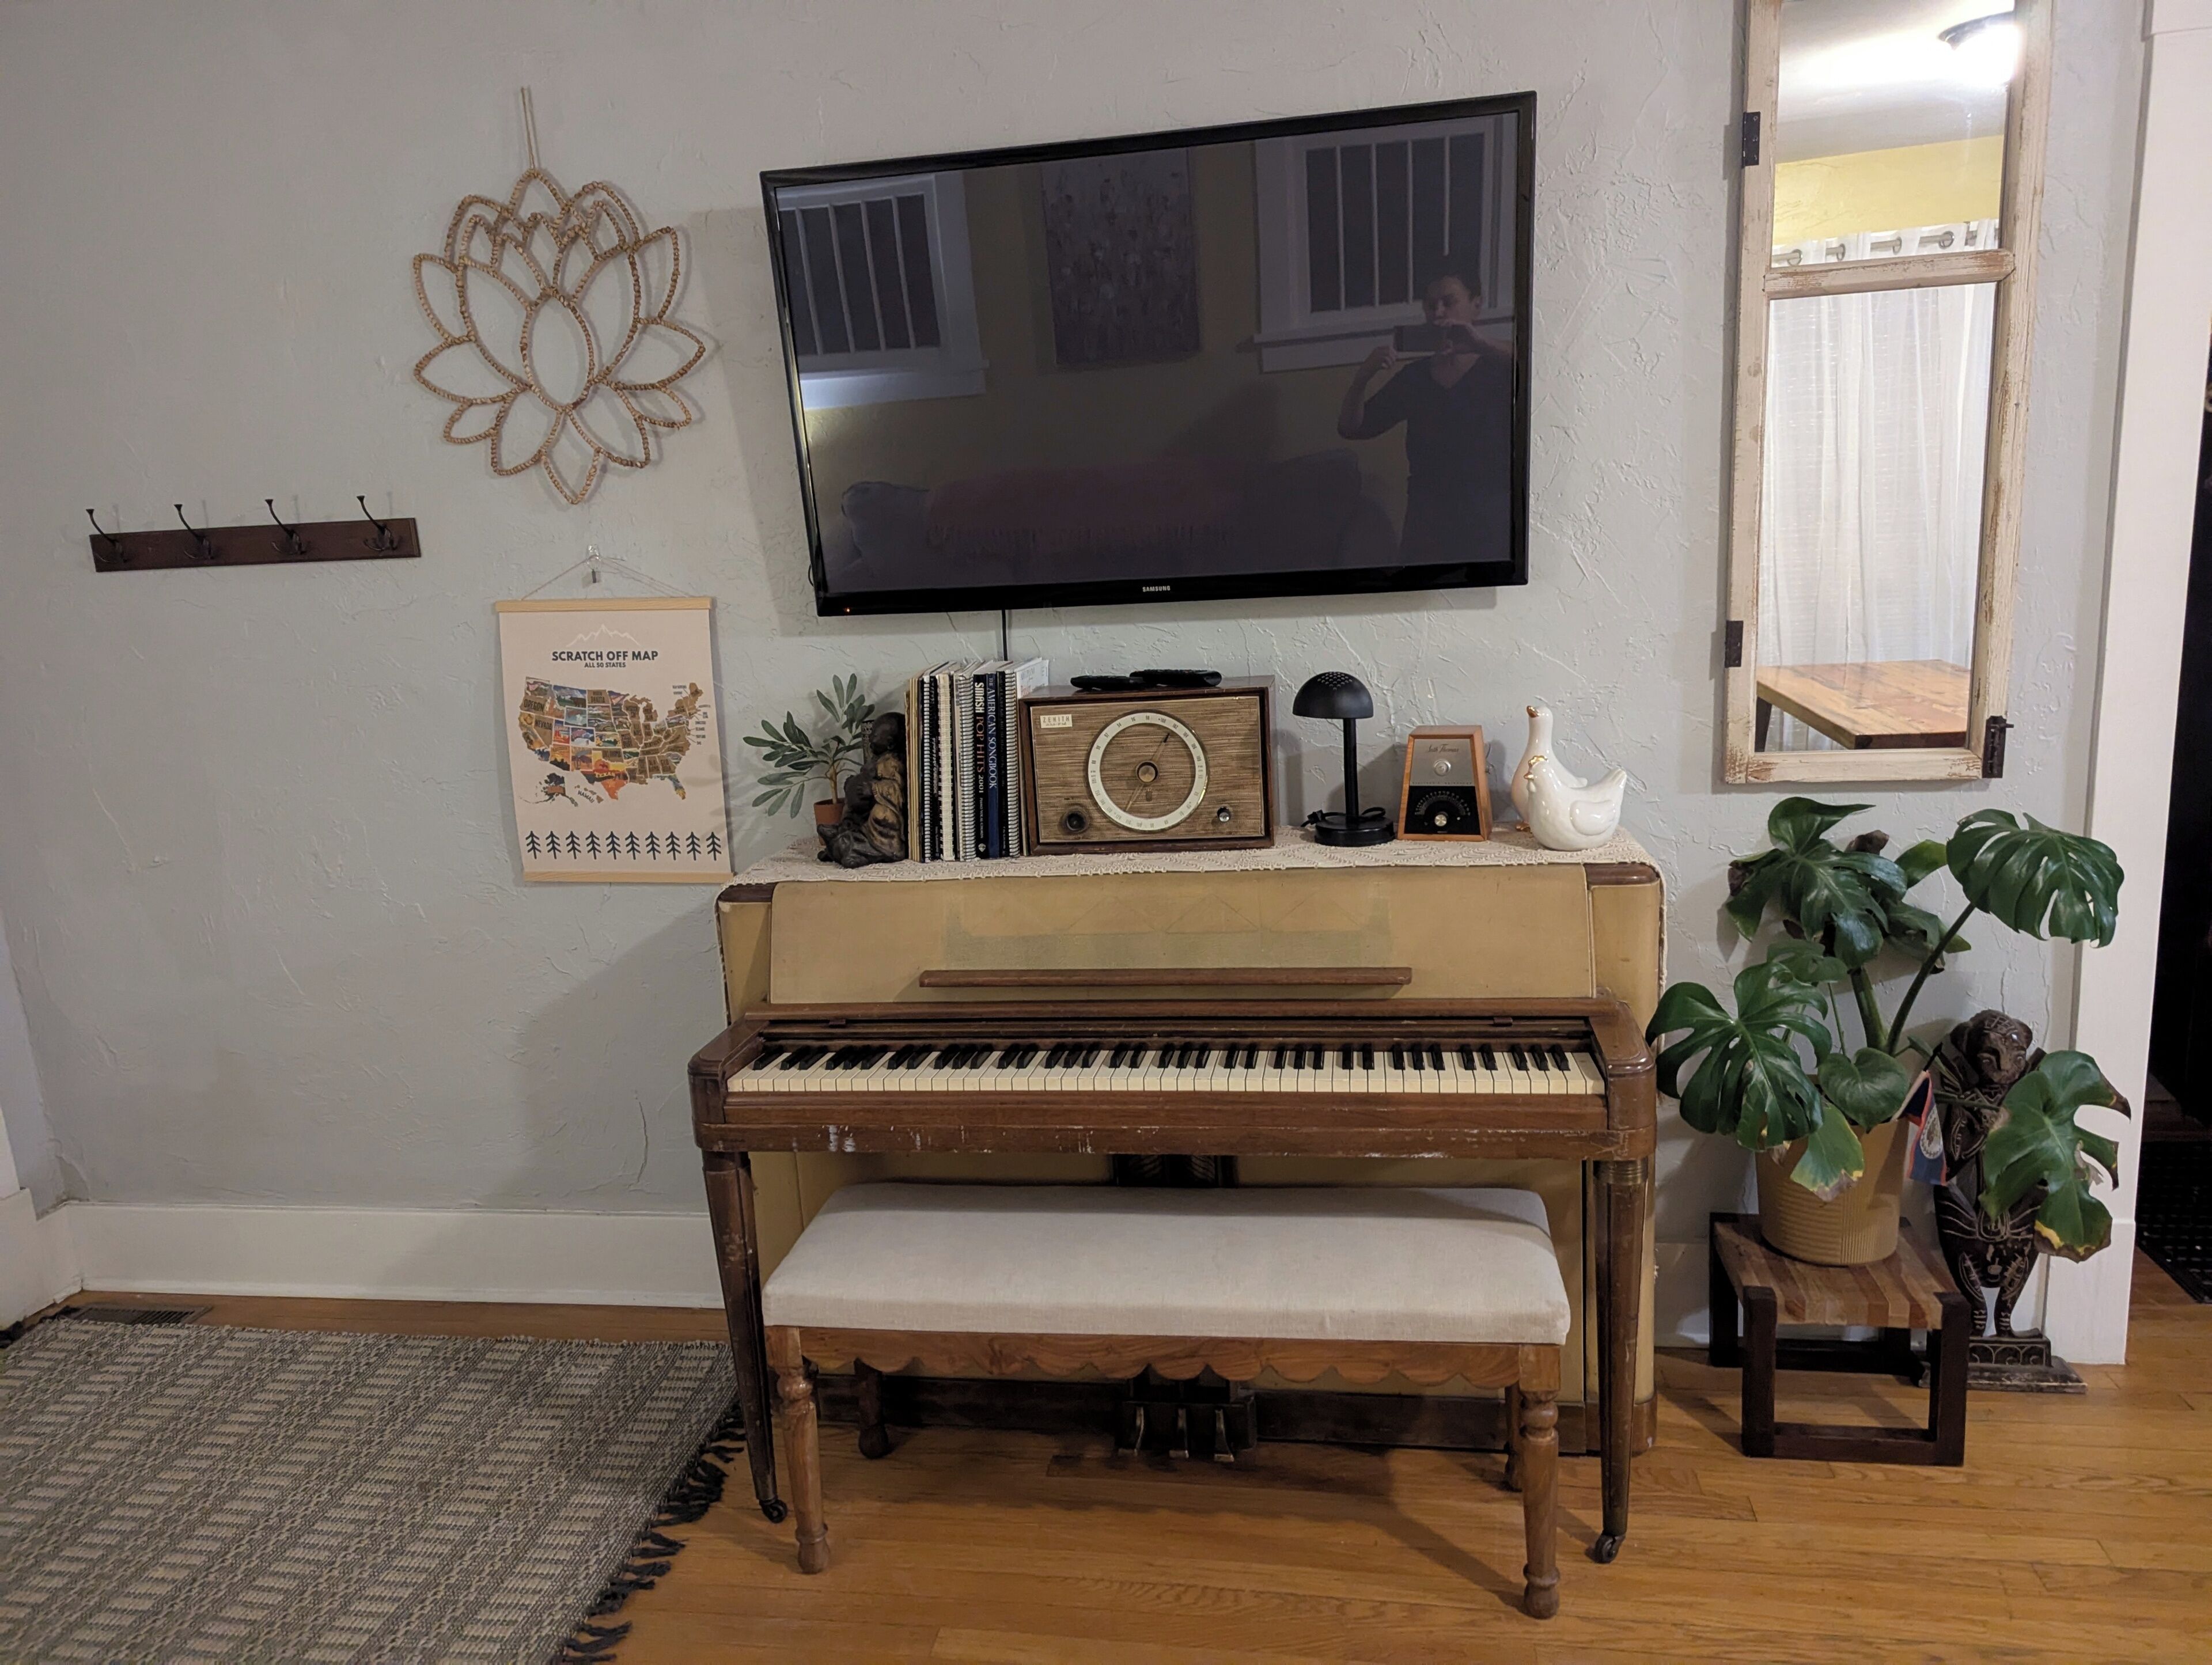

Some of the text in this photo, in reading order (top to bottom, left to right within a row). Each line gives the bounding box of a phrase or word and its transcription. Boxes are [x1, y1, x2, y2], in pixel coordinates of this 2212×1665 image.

[552, 651, 658, 661] SCRATCH OFF MAP
[524, 699, 544, 712] OREGON
[975, 682, 985, 713] SMASH
[535, 718, 552, 729] NEVADA
[987, 688, 995, 735] AMERICAN
[976, 716, 984, 741] POP
[976, 744, 985, 773] HITS
[988, 737, 998, 789] SONGBOOK
[578, 790, 595, 803] HAWAII
